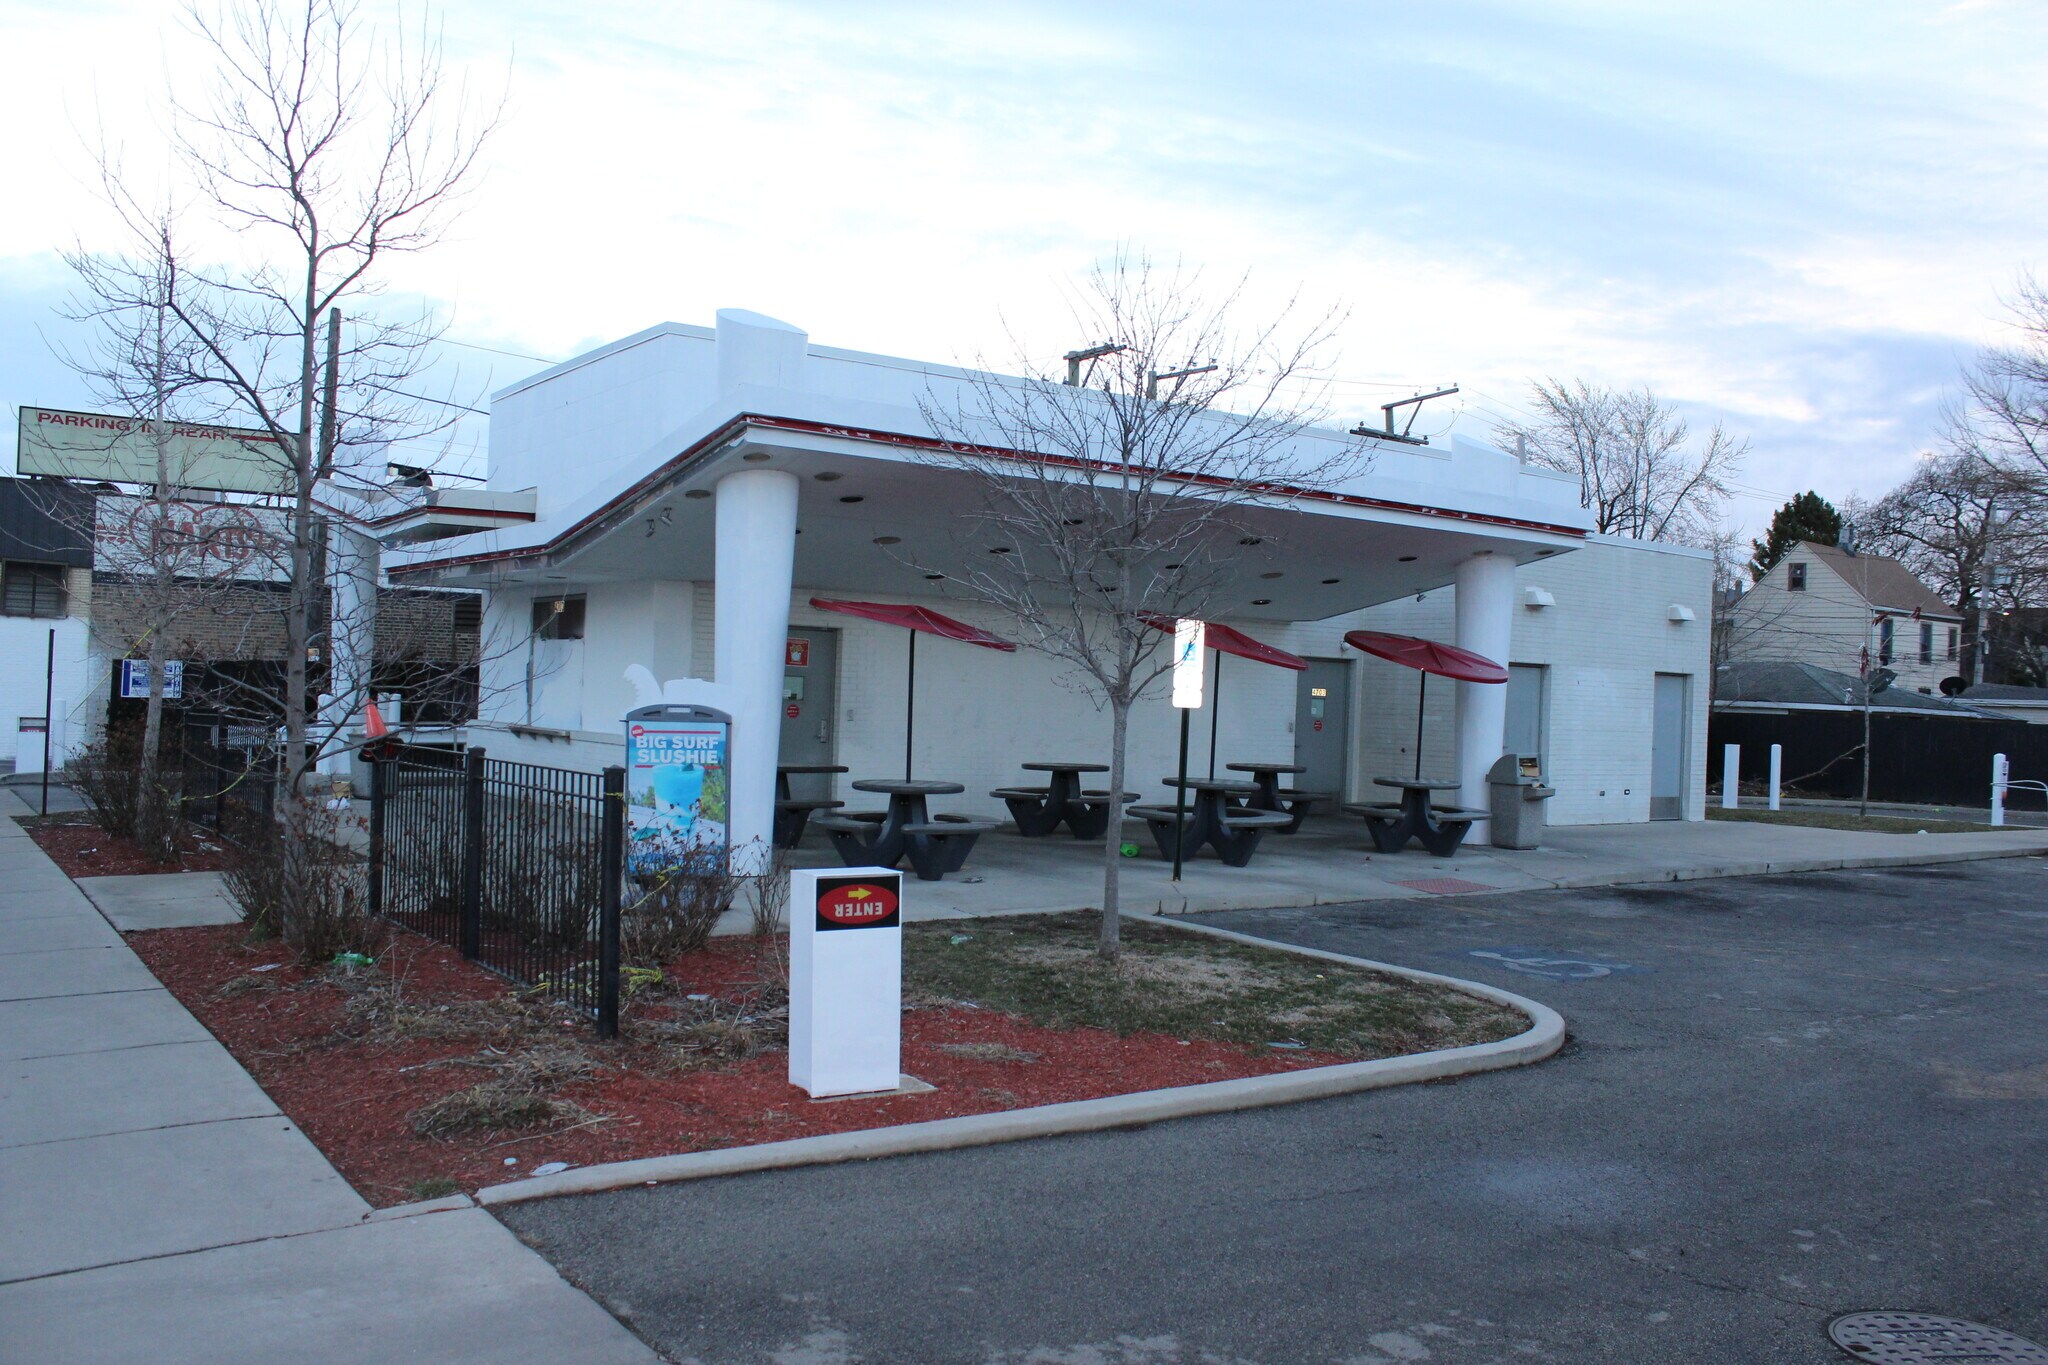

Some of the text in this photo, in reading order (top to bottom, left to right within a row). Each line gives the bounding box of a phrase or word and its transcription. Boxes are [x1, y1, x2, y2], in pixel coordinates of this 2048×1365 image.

[37, 412, 130, 432] PARKING
[636, 735, 718, 749] BIG SURF
[637, 749, 718, 764] SLUSHIE
[834, 902, 883, 917] ENTER
